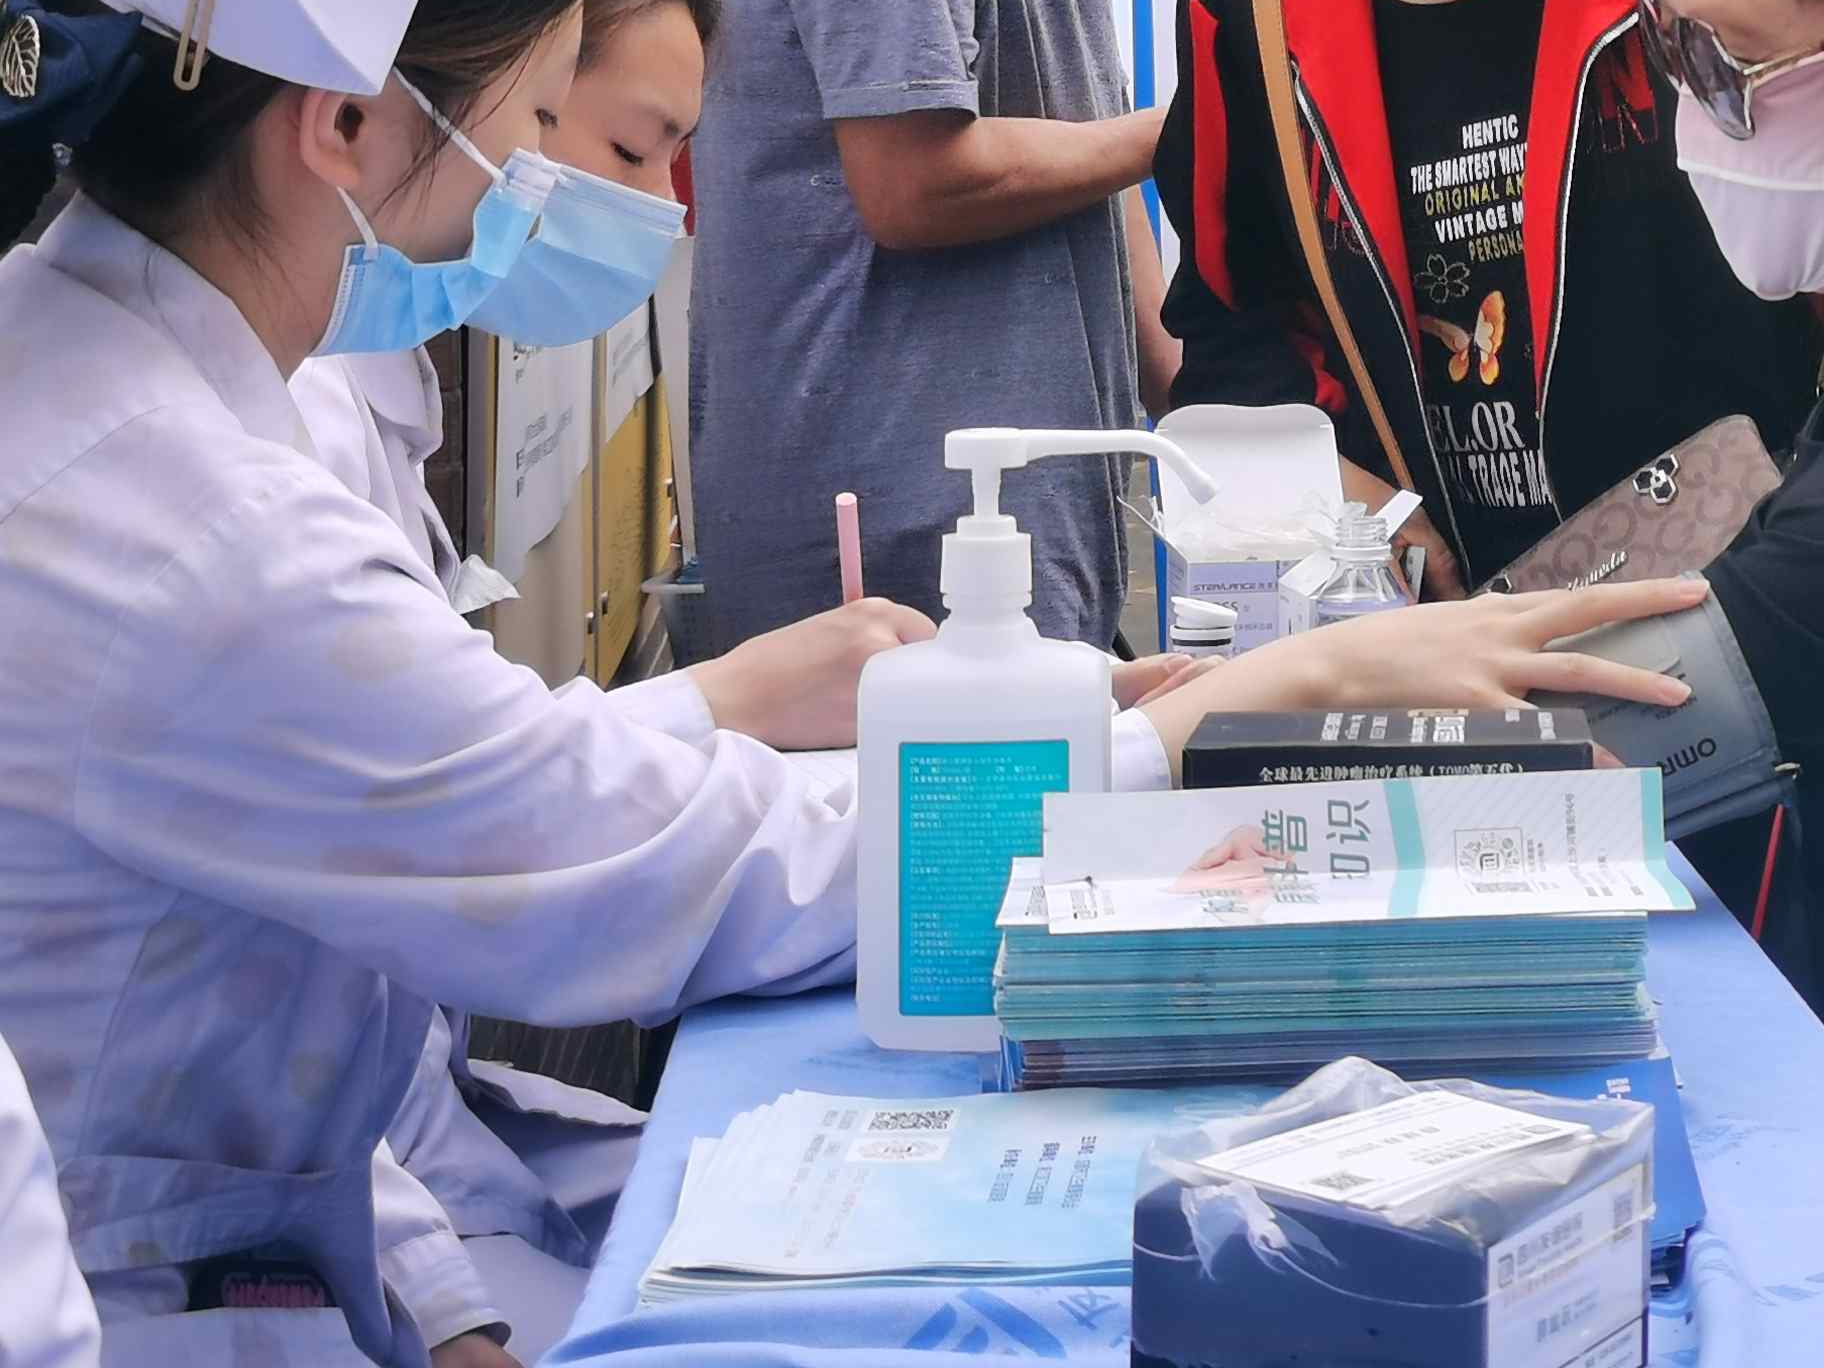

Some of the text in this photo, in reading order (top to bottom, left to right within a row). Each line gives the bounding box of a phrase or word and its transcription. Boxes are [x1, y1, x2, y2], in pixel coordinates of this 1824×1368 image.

[1410, 163, 1433, 195] THE
[1434, 149, 1497, 189] SMARTEST
[1424, 179, 1500, 216] ORIGINAL
[1434, 204, 1508, 244] VINTAGE
